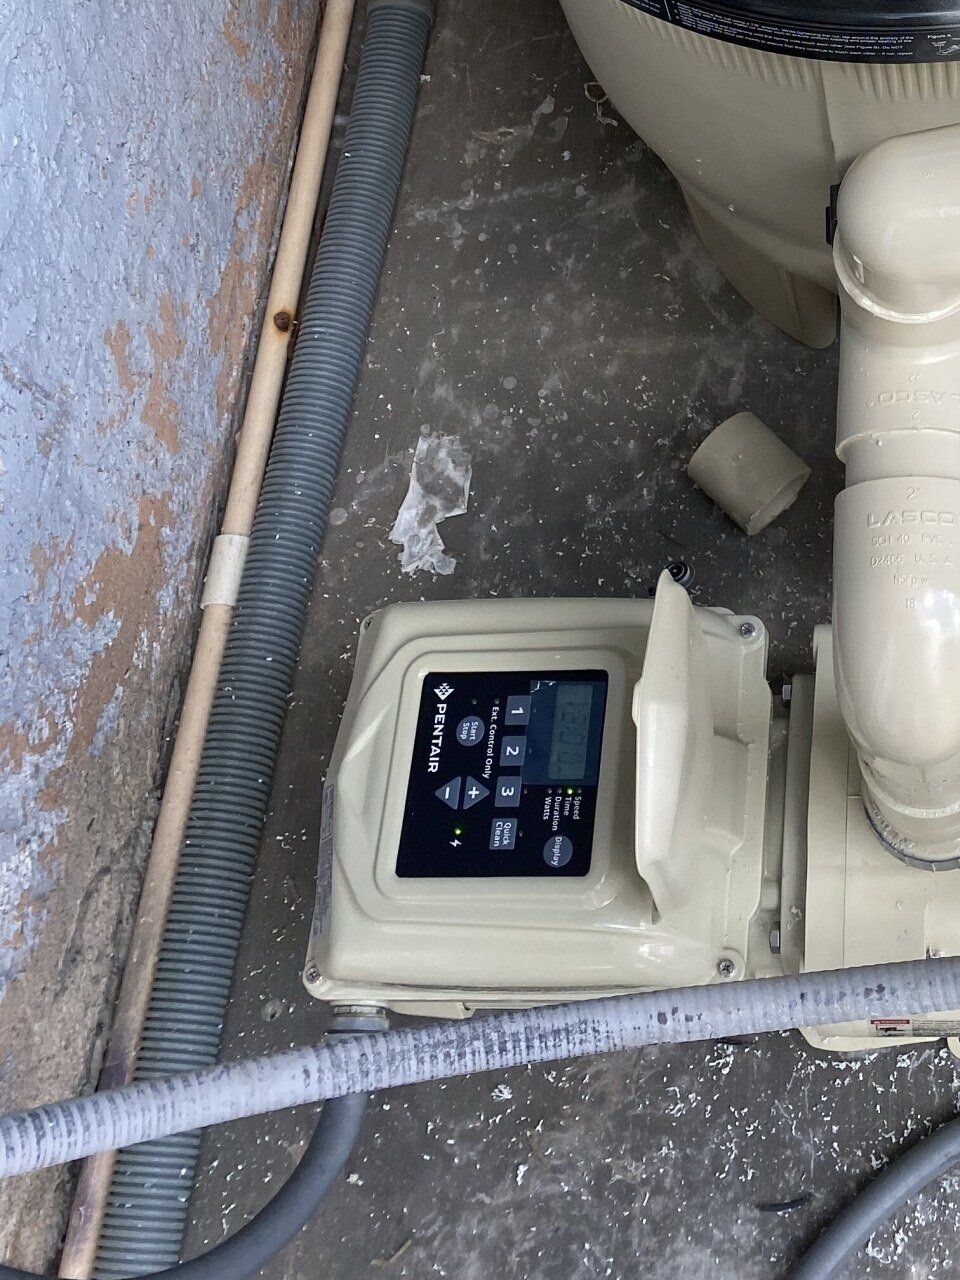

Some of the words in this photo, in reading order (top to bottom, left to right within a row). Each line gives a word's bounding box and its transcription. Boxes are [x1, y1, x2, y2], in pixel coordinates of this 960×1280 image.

[866, 509, 955, 529] LASCO
[490, 706, 499, 723] Ext.
[511, 707, 524, 715] 1
[427, 703, 448, 773] PENTAIR
[459, 722, 470, 740] Stop
[469, 721, 479, 741] Start
[486, 724, 497, 757] Control
[506, 747, 519, 756] 2
[482, 758, 493, 779] Only
[501, 787, 514, 797] 3
[543, 797, 552, 820] Watts
[552, 796, 562, 831] Duration
[564, 797, 572, 816] Time
[573, 796, 582, 820] Speed
[494, 821, 504, 847] Clean
[503, 822, 511, 845] Quick
[551, 836, 562, 867] Display
